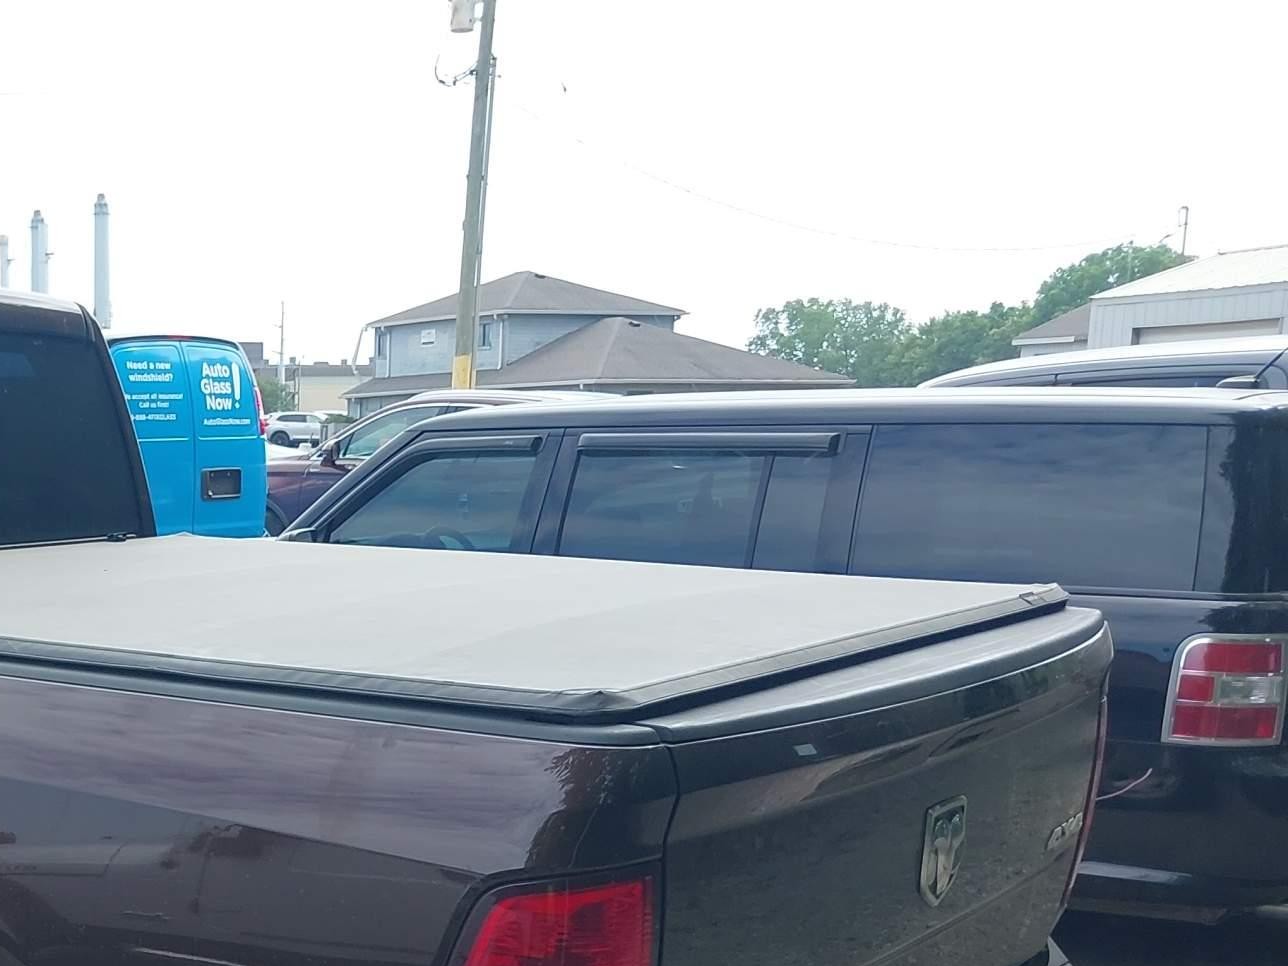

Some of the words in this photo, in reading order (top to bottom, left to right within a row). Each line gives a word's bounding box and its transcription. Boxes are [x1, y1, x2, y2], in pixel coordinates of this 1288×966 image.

[126, 361, 147, 370] Need
[203, 363, 230, 378] Auto
[201, 379, 231, 394] Glass
[206, 394, 232, 409] Now
